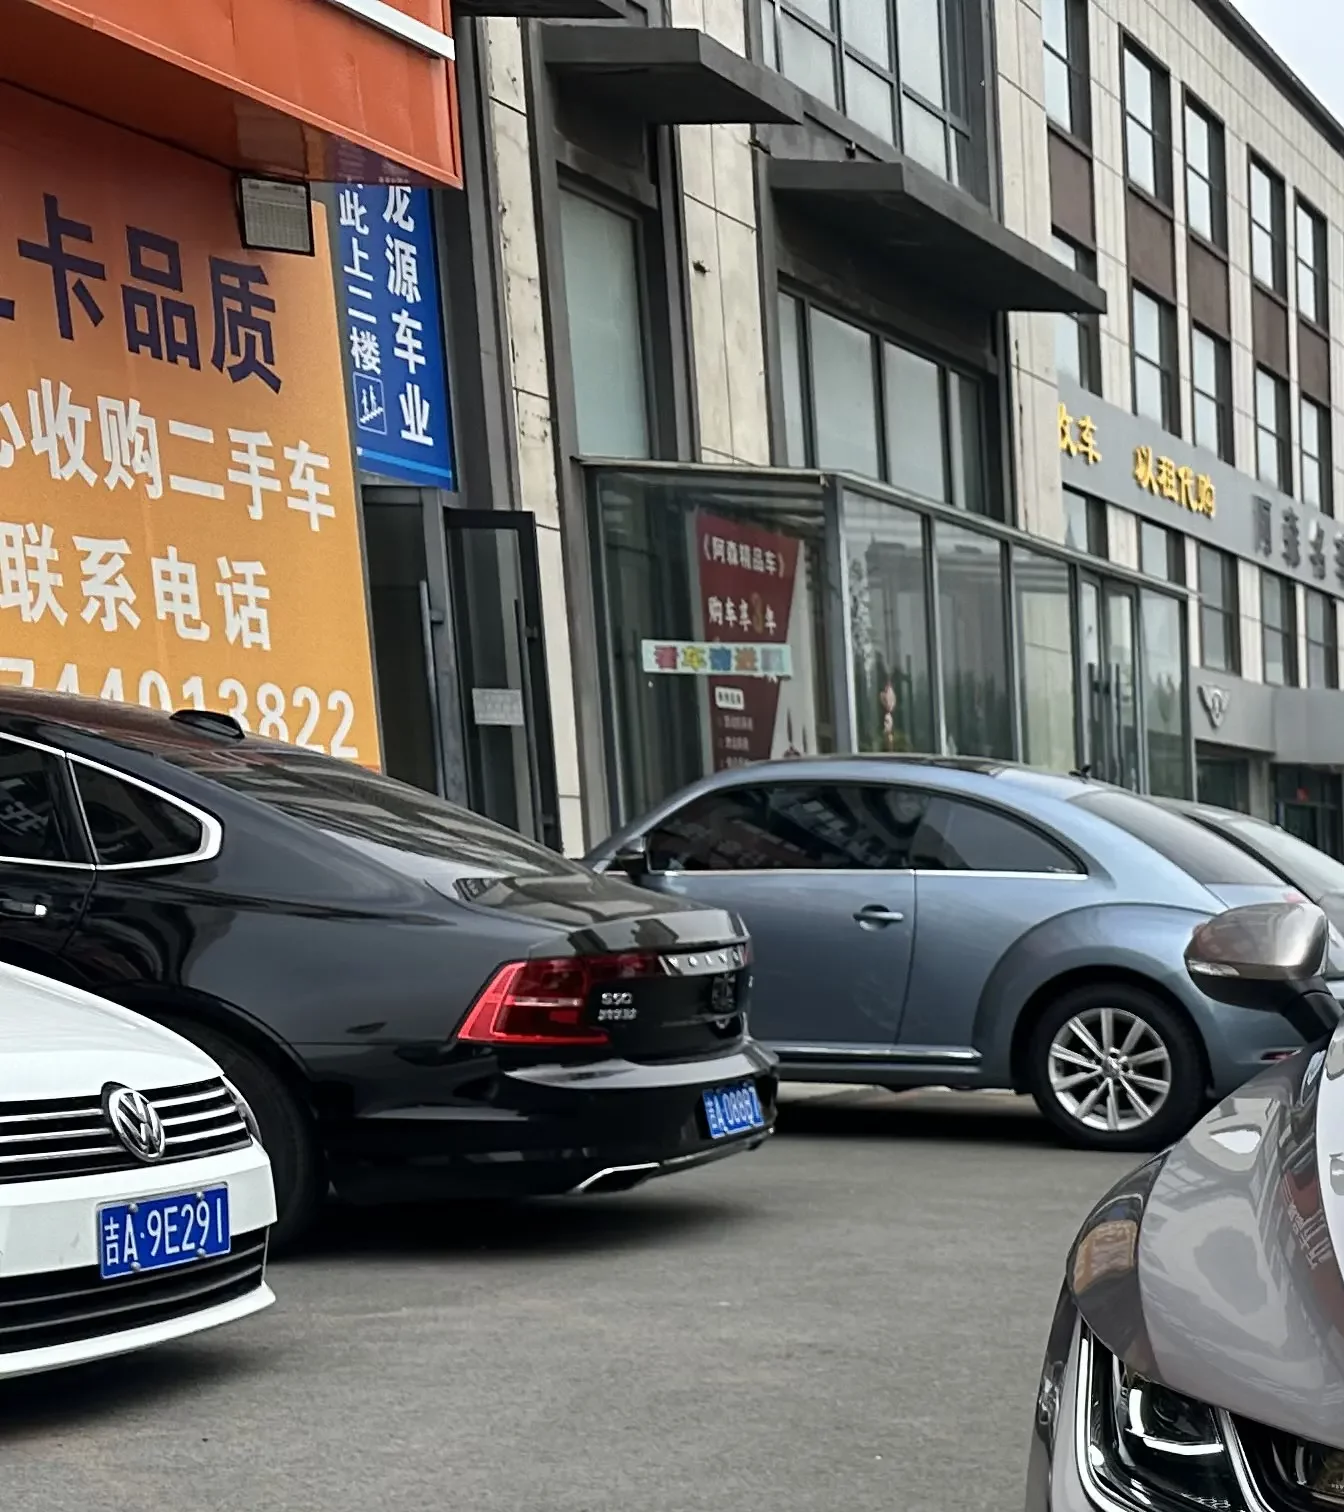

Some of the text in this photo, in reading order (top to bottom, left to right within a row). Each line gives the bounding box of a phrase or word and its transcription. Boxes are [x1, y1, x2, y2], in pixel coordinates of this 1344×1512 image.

[0, 193, 282, 395] 卡品质
[339, 184, 381, 374] 此上二楼
[382, 185, 434, 447] 龙源车业
[0, 522, 271, 651] 联系电话
